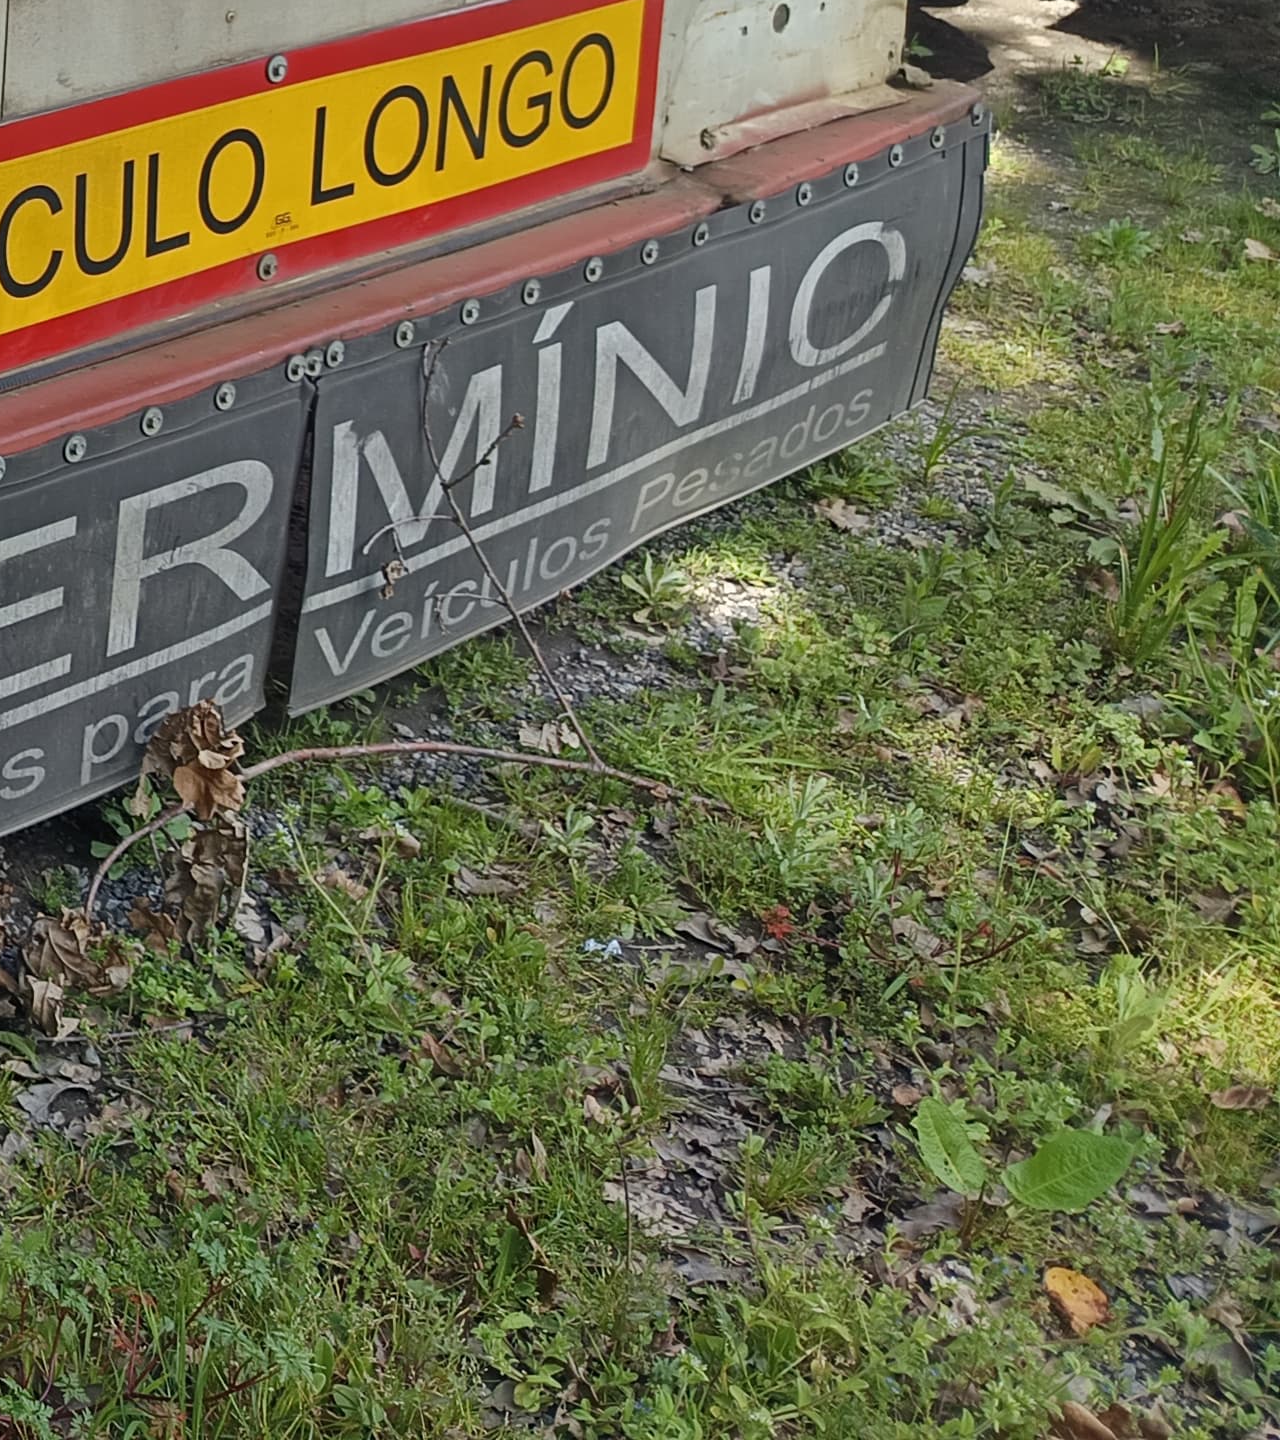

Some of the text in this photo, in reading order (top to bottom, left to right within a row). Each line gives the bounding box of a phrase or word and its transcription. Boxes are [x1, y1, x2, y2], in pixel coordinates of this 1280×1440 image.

[310, 32, 616, 206] LONGO
[81, 652, 255, 785] para
[314, 515, 611, 677] Veículos
[630, 387, 874, 534] Pesados
